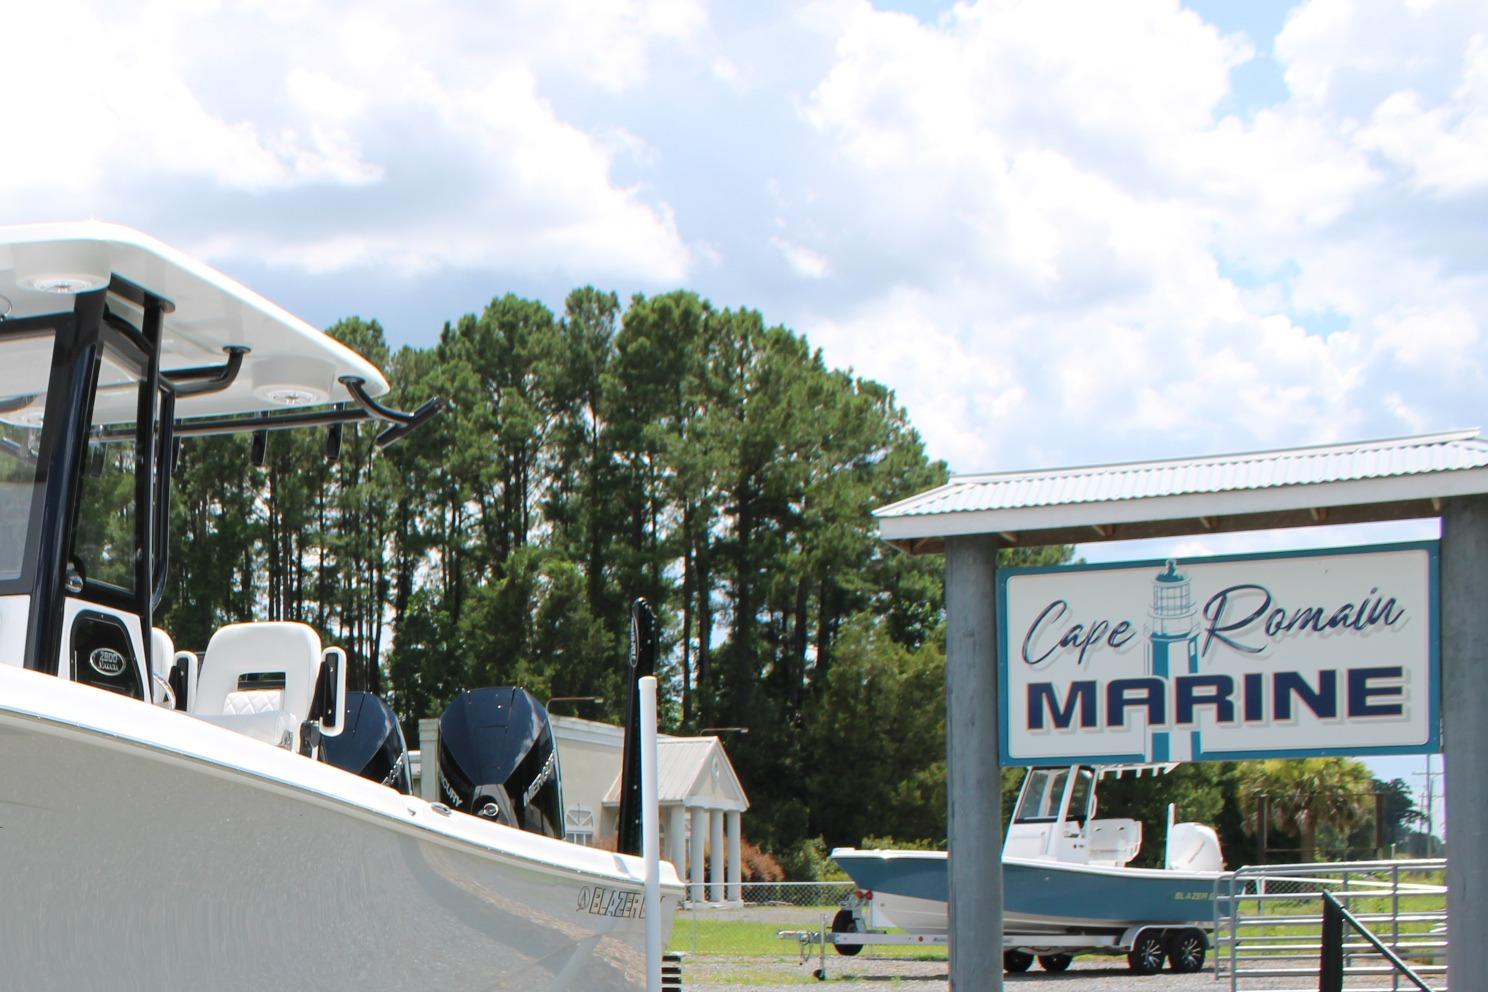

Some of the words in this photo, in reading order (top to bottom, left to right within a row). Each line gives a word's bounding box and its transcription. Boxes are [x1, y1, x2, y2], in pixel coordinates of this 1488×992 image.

[1022, 600, 1136, 666] Cape
[1201, 583, 1406, 658] Romain
[1026, 665, 1404, 731] MARINE
